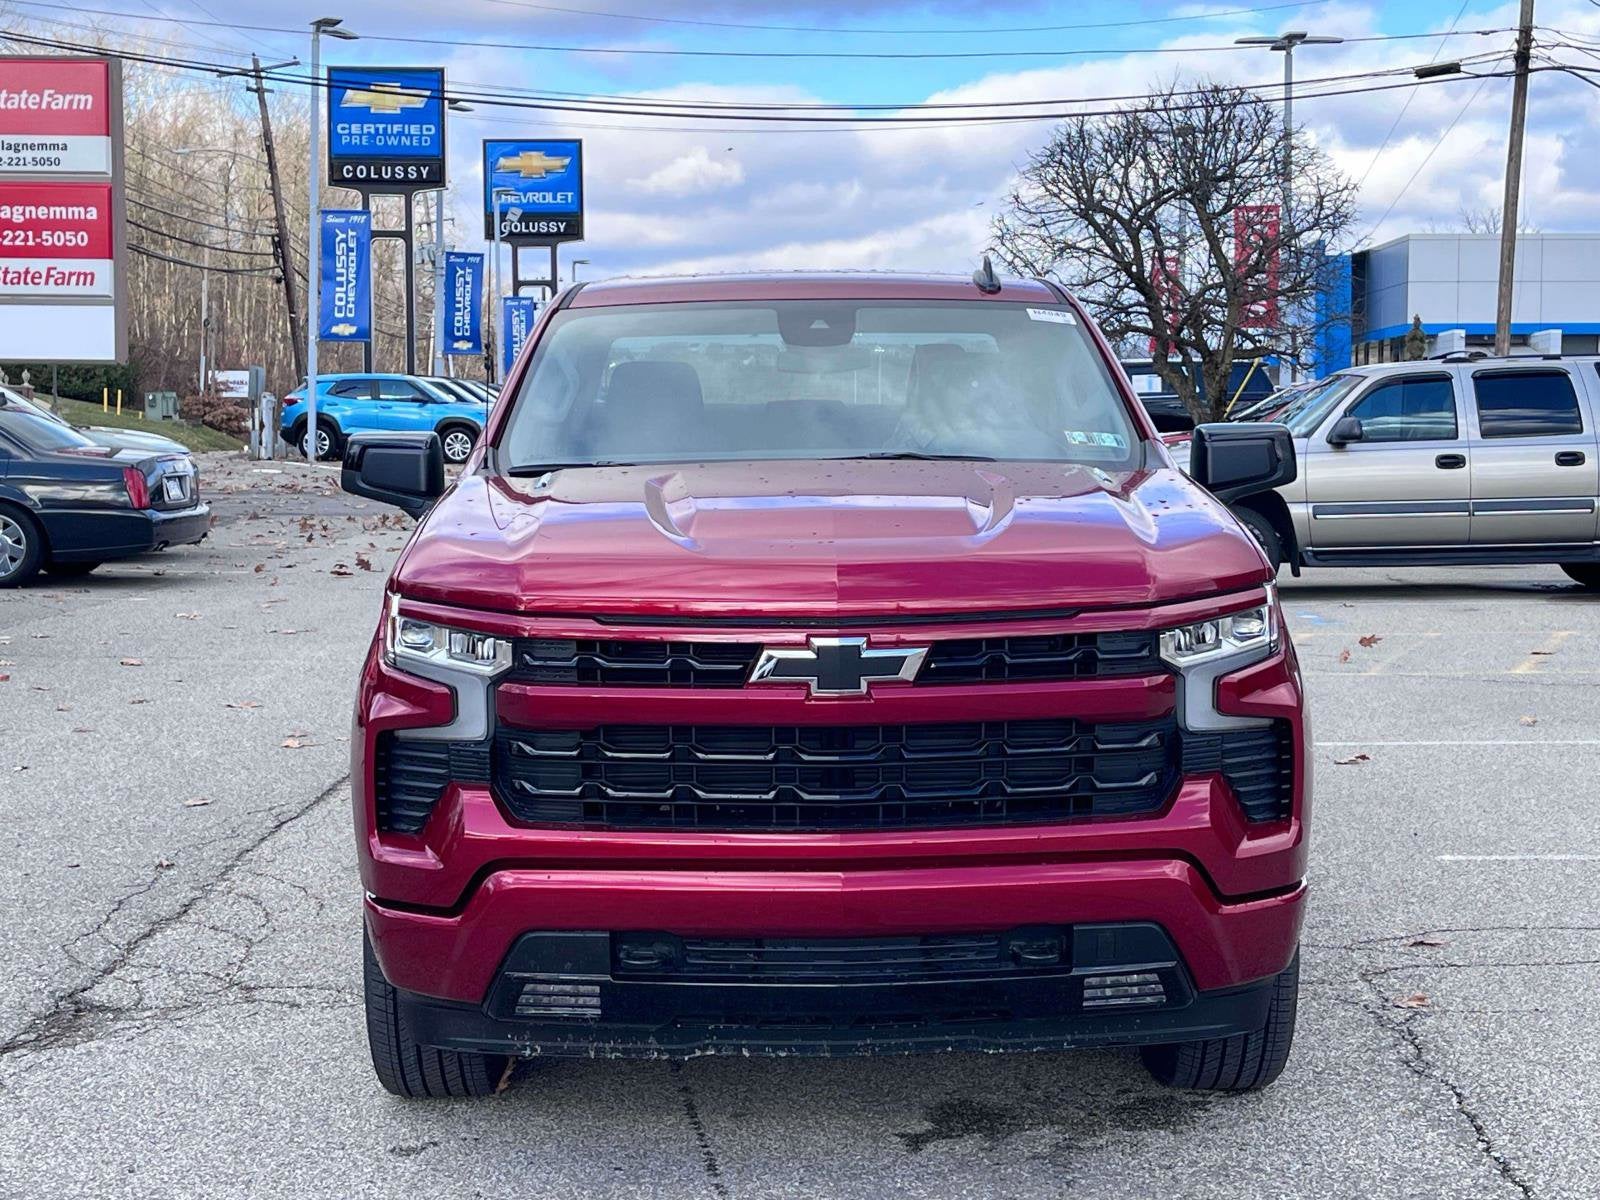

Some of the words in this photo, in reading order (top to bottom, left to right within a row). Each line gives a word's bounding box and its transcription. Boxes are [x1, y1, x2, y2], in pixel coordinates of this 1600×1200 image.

[336, 123, 436, 135] CERTIFIED
[341, 135, 431, 146] PRE-OWNED
[342, 165, 429, 179] COLUSSY
[498, 191, 574, 203] HEVROLET
[501, 222, 566, 233] COLUSSY
[334, 228, 347, 318] COLUSSY
[346, 228, 357, 318] CHEVROLET
[454, 266, 465, 336] COLUSSY
[463, 267, 473, 336] CHEVROLET
[512, 307, 520, 361] OLUSSY
